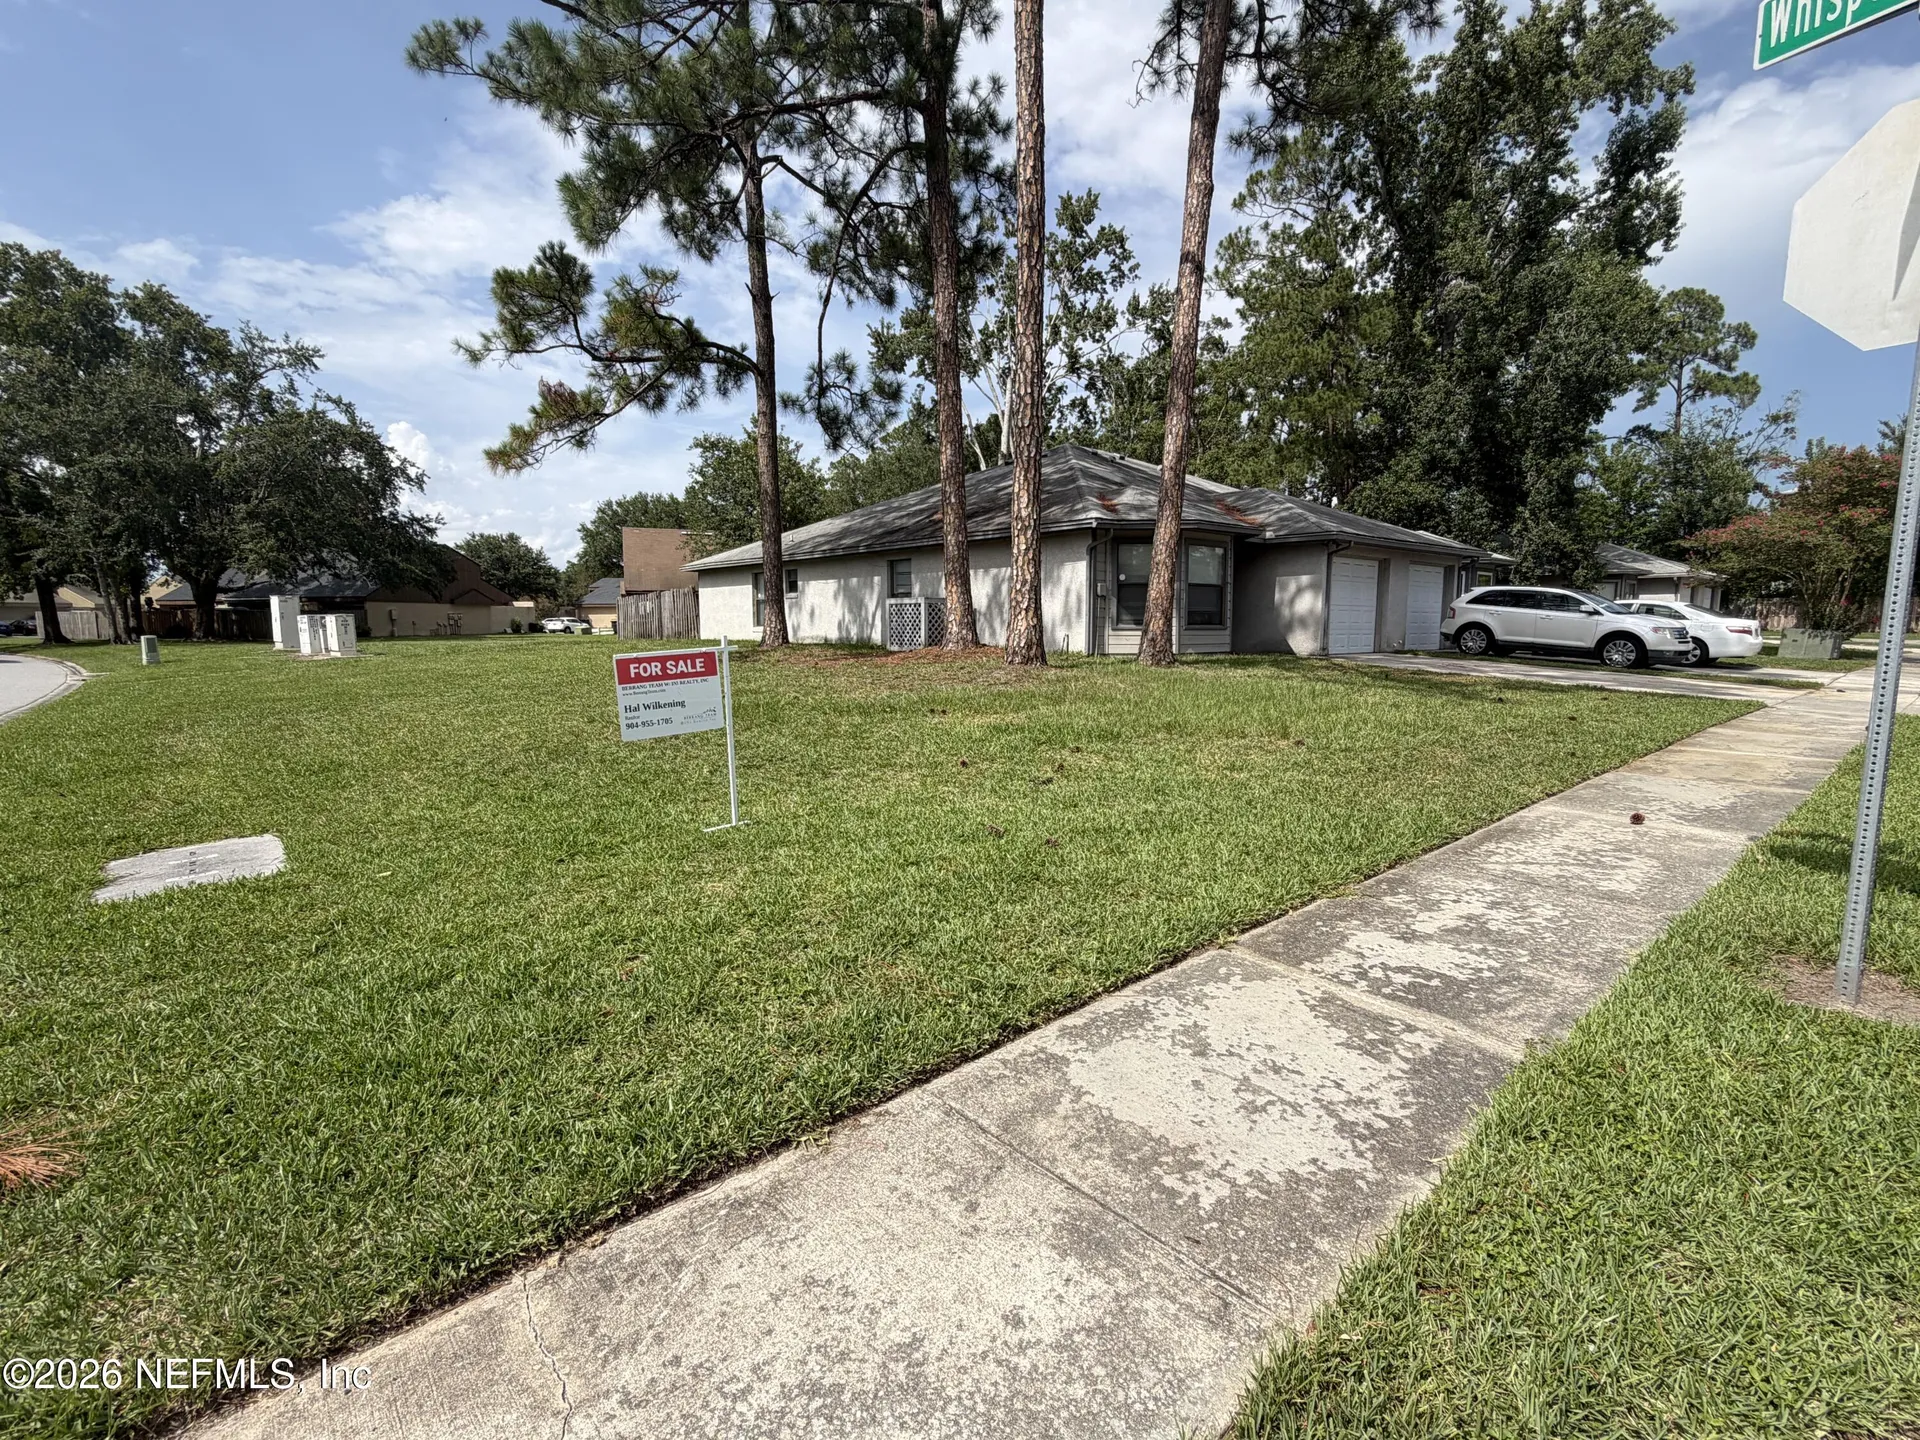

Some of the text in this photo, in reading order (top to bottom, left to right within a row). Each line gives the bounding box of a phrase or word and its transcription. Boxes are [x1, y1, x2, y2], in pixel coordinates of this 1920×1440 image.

[629, 658, 705, 678] FOR SALE
[624, 699, 686, 714] Hal Wilkening
[625, 717, 673, 730] 904-955-1705
